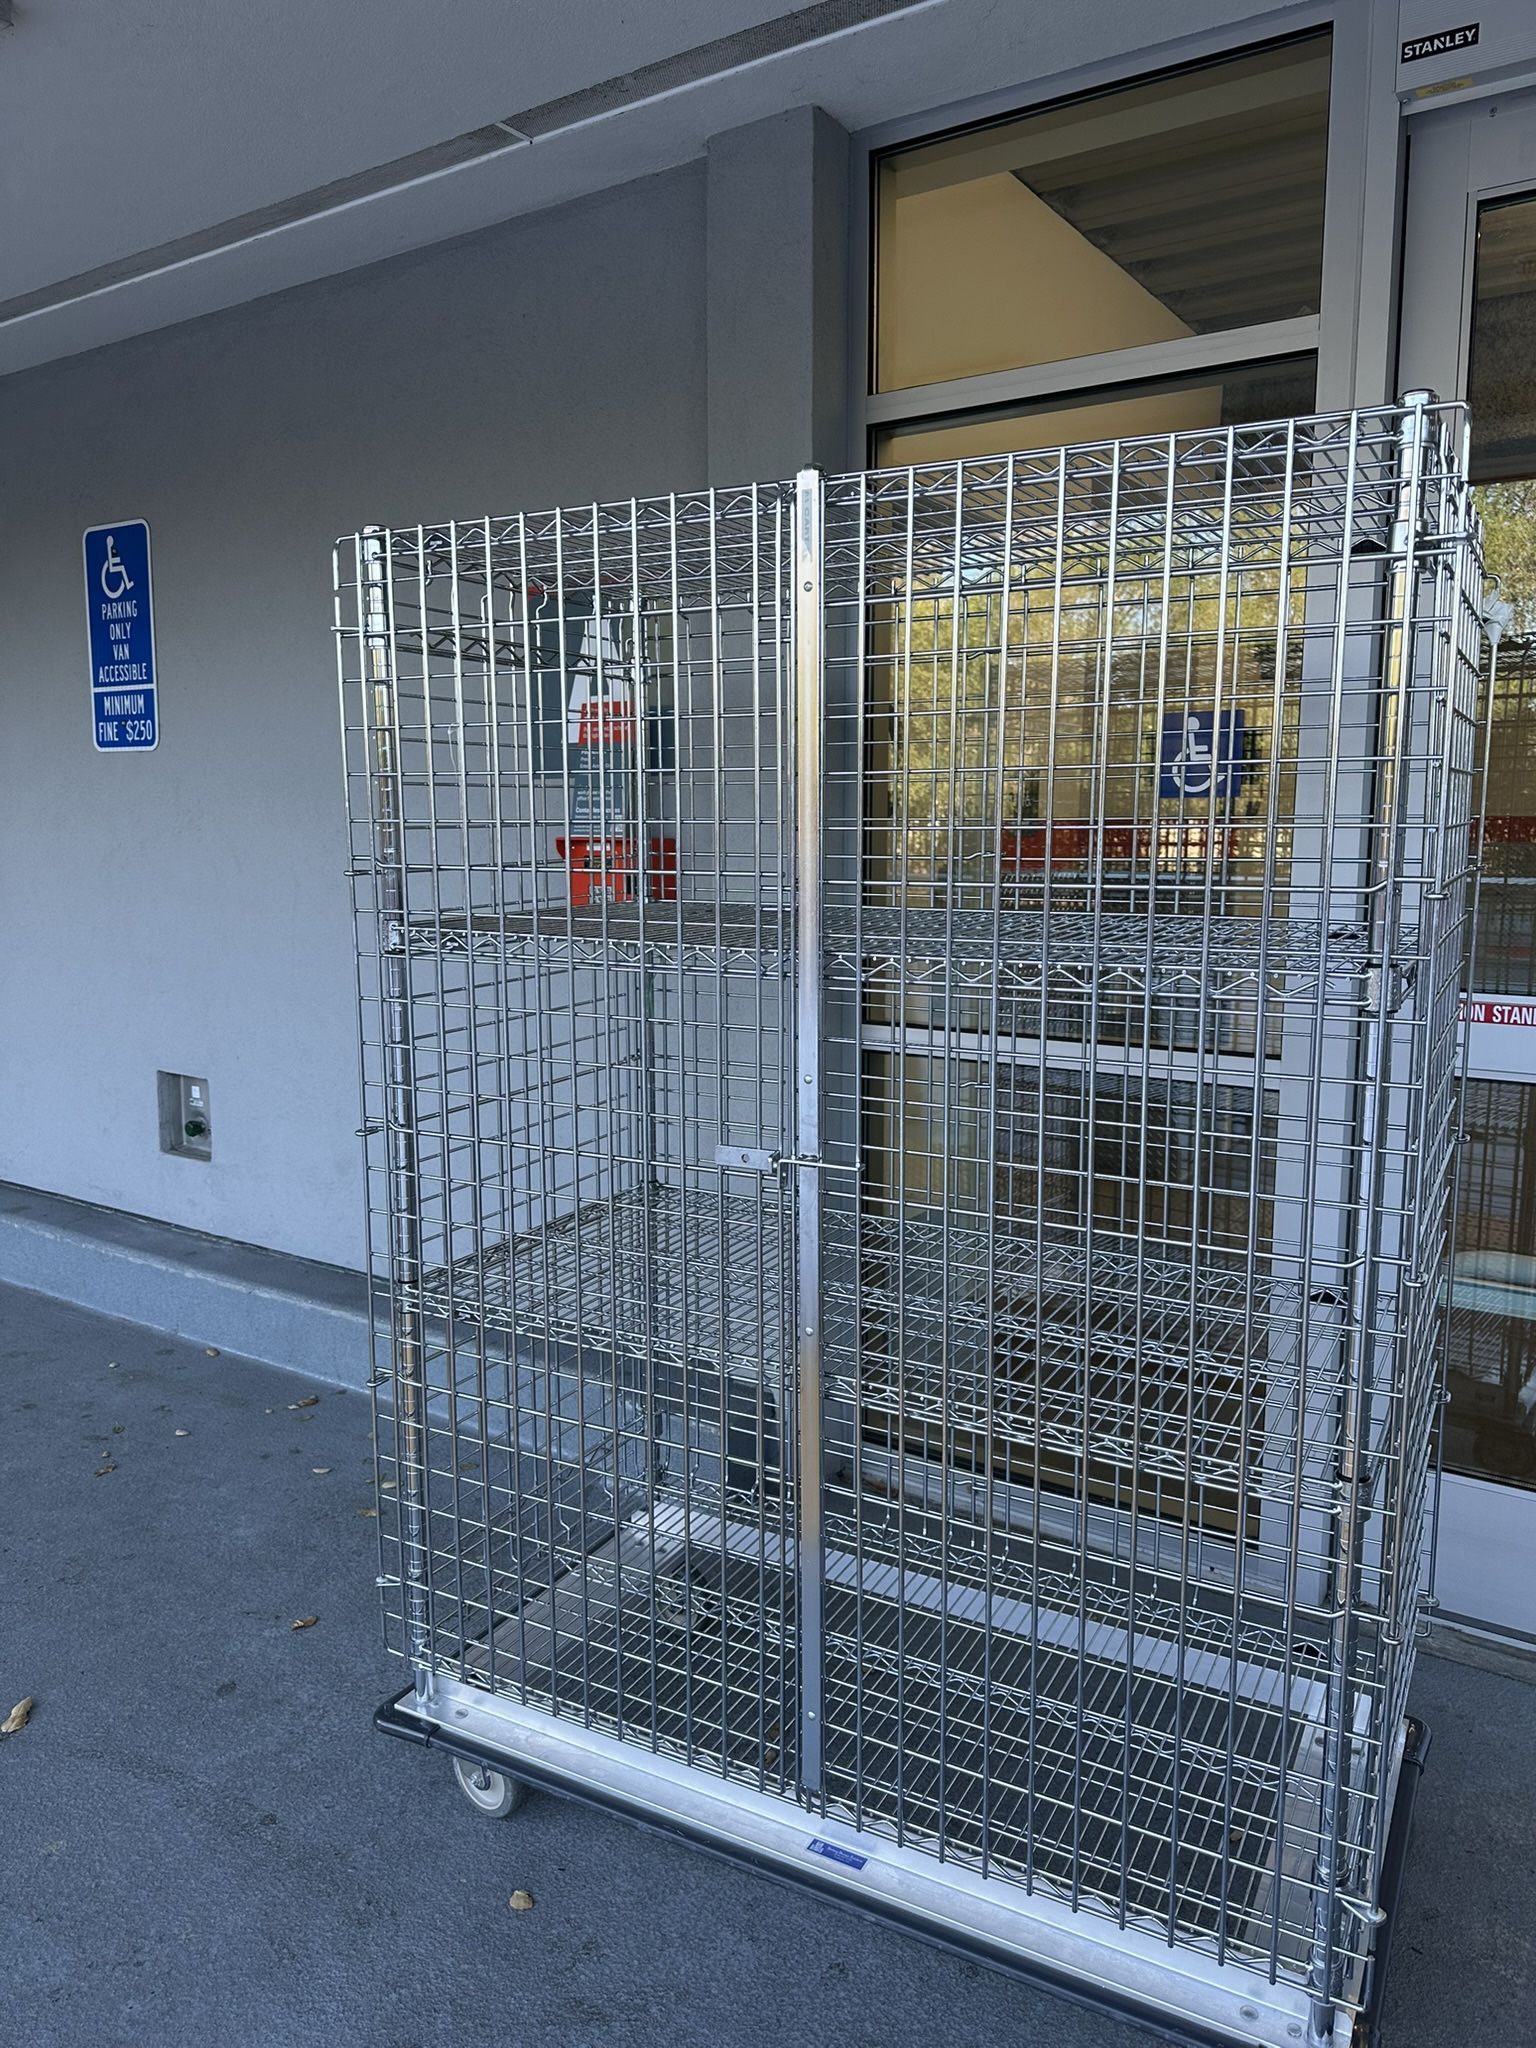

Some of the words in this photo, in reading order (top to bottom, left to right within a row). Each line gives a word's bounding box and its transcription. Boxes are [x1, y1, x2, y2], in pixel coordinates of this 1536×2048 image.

[1403, 28, 1477, 59] STANLEY
[101, 600, 138, 621] PARKING
[109, 622, 132, 641] ONLY
[112, 643, 130, 660] VAN
[98, 663, 148, 684] ACCESSIBLE
[103, 694, 145, 716] MINIMUM
[98, 721, 119, 742] FINE
[125, 719, 153, 743] $250
